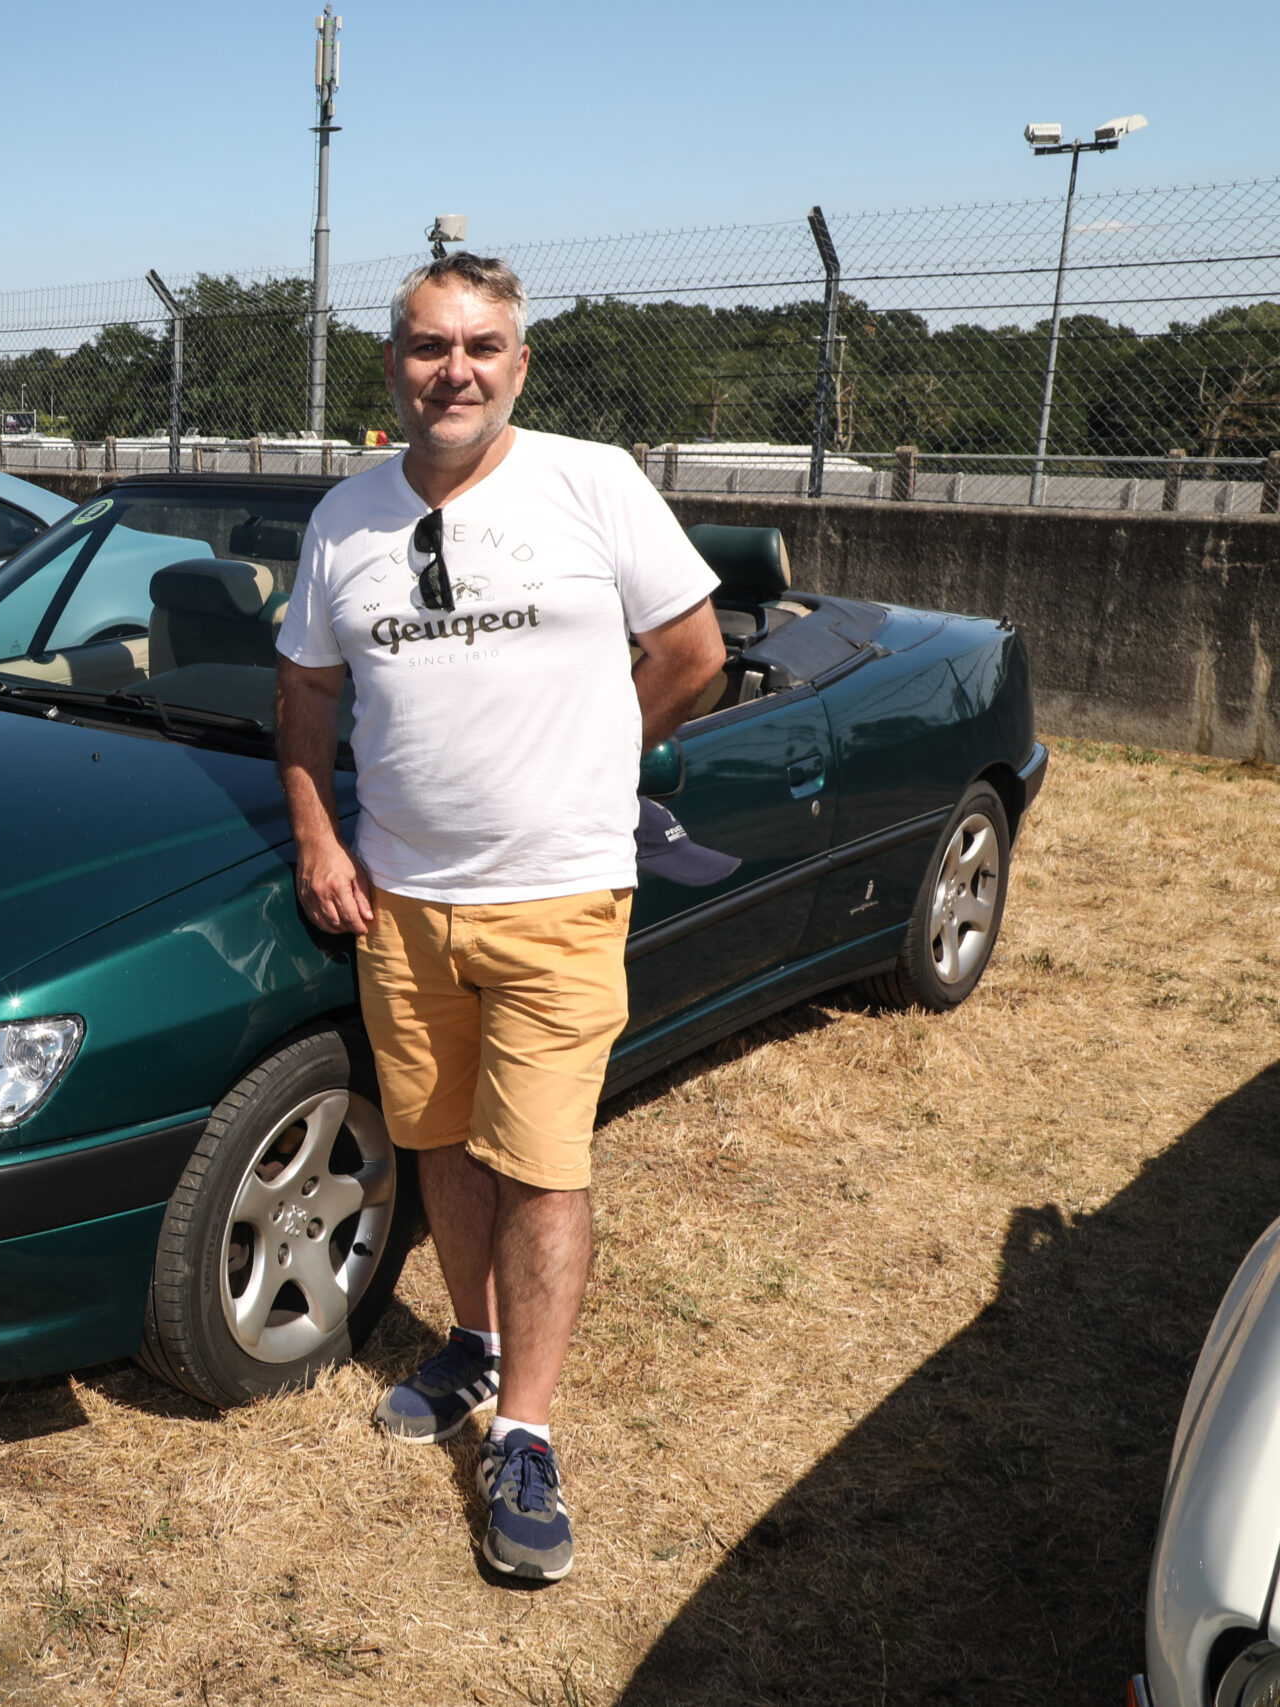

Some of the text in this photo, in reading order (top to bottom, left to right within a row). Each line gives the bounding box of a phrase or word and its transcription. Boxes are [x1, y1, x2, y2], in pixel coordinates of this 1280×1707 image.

[369, 523, 534, 583] LEEND
[371, 604, 542, 655] Peugeot
[408, 648, 500, 667] SINCE 1810
